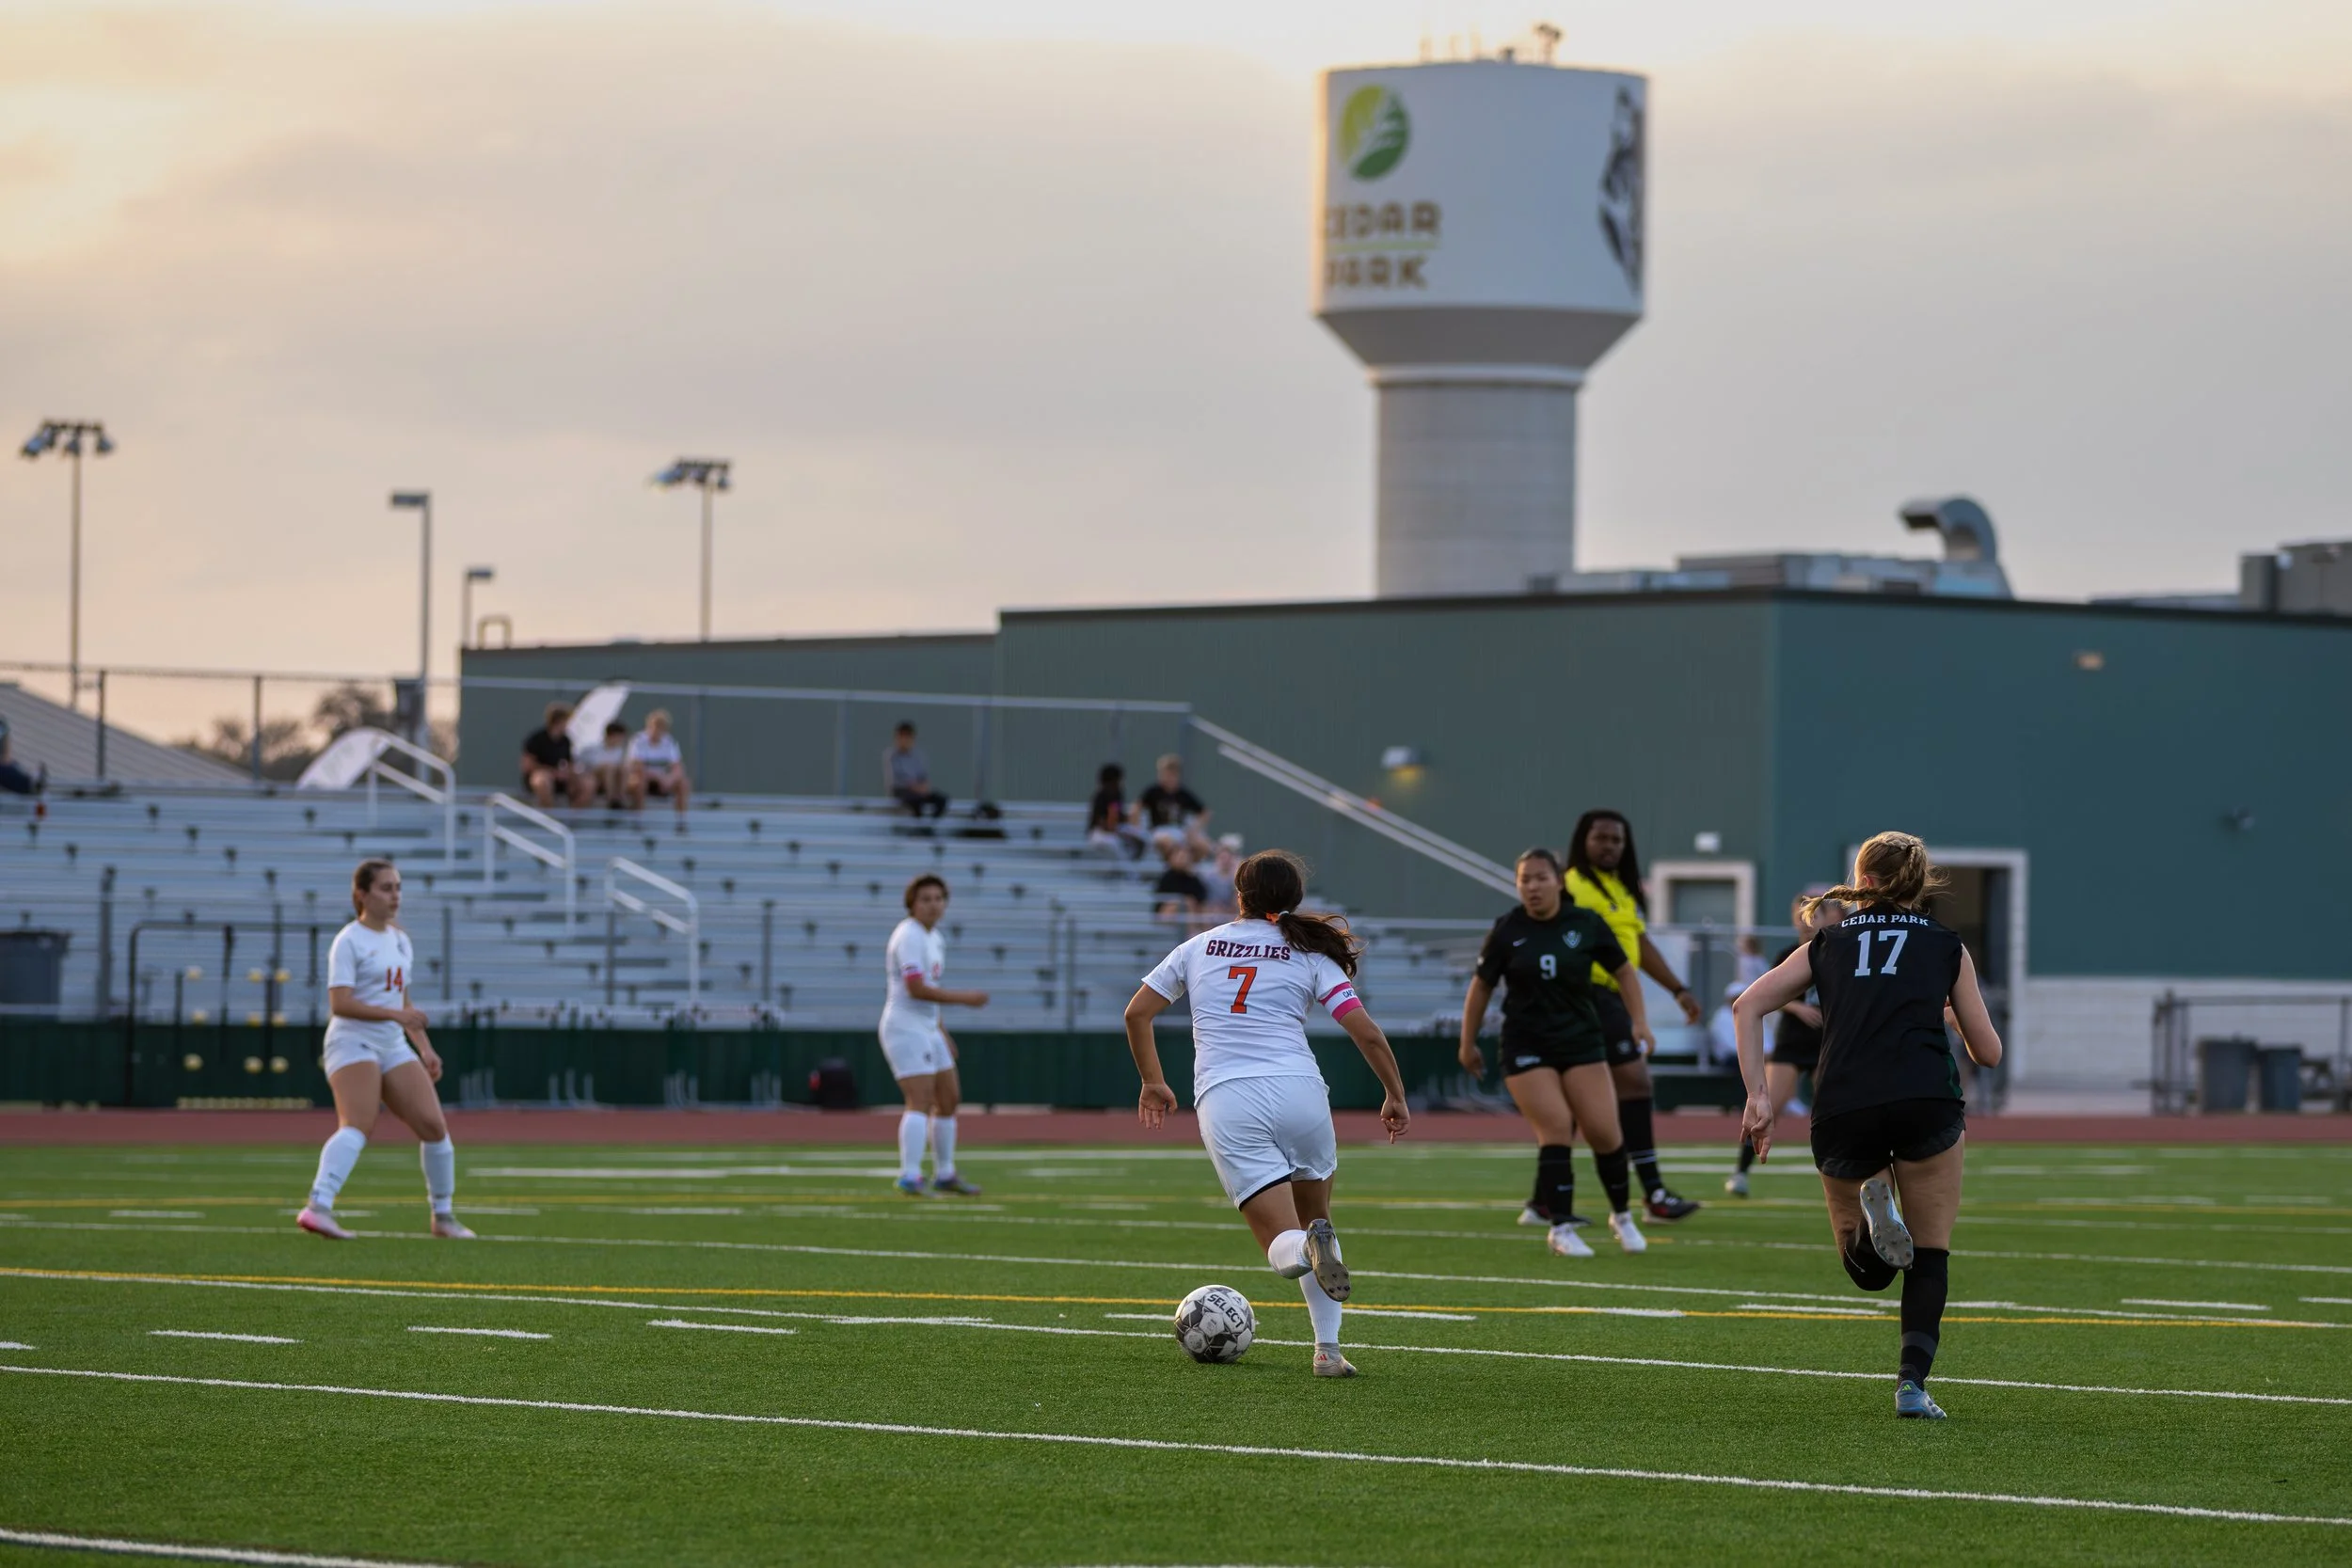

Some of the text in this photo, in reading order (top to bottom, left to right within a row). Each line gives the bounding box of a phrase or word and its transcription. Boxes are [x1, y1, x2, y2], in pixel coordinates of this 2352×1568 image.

[1841, 914, 1929, 928] CEDAR PARK
[1205, 939, 1291, 961] GRIZZLIES
[1854, 929, 1908, 976] 17
[384, 966, 405, 993] 14
[1539, 954, 1557, 980] 9
[1227, 965, 1258, 1014] 7
[1207, 1293, 1245, 1328] SELECT
